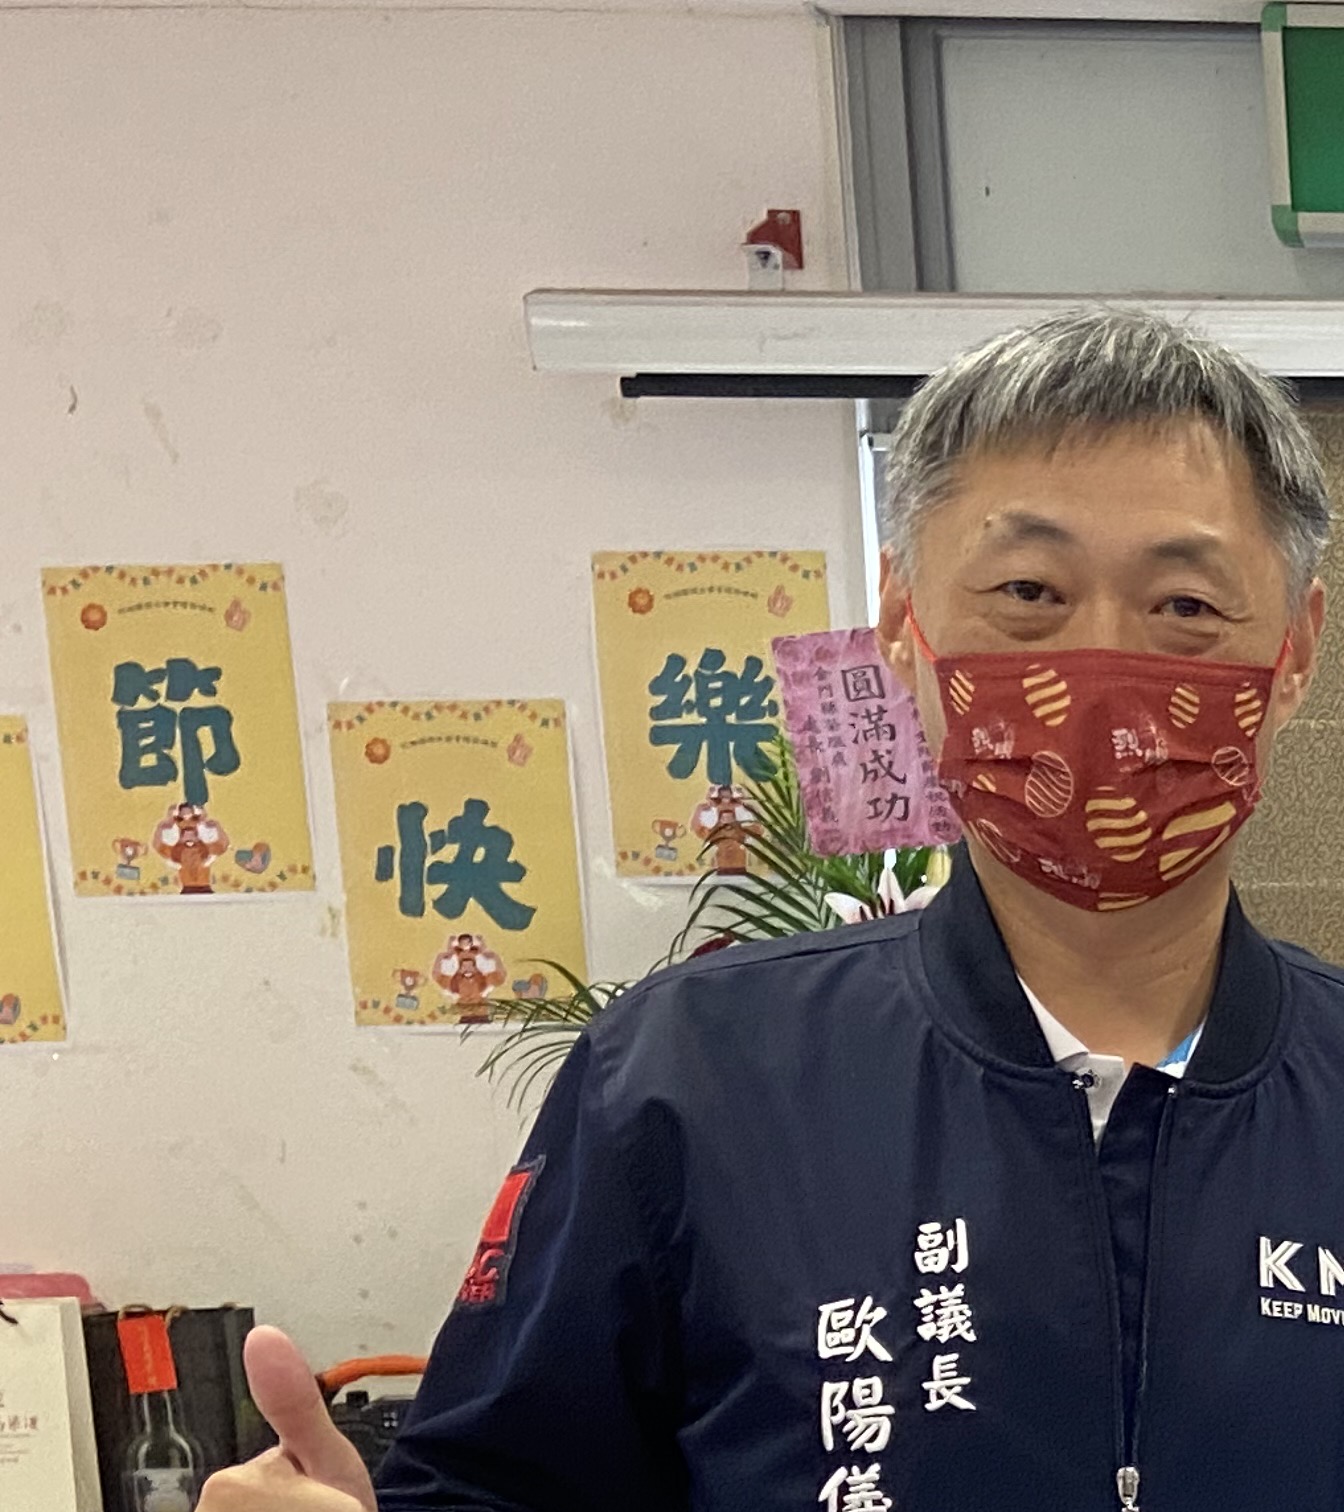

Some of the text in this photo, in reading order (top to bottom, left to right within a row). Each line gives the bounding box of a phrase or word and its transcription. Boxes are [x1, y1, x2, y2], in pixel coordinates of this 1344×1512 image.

[111, 658, 242, 808] 節
[648, 647, 779, 787] 樂
[841, 664, 910, 823] 圓滿成功
[374, 797, 538, 931] 快
[913, 1217, 977, 1412] 副議長
[1260, 1296, 1303, 1319] KEEP
